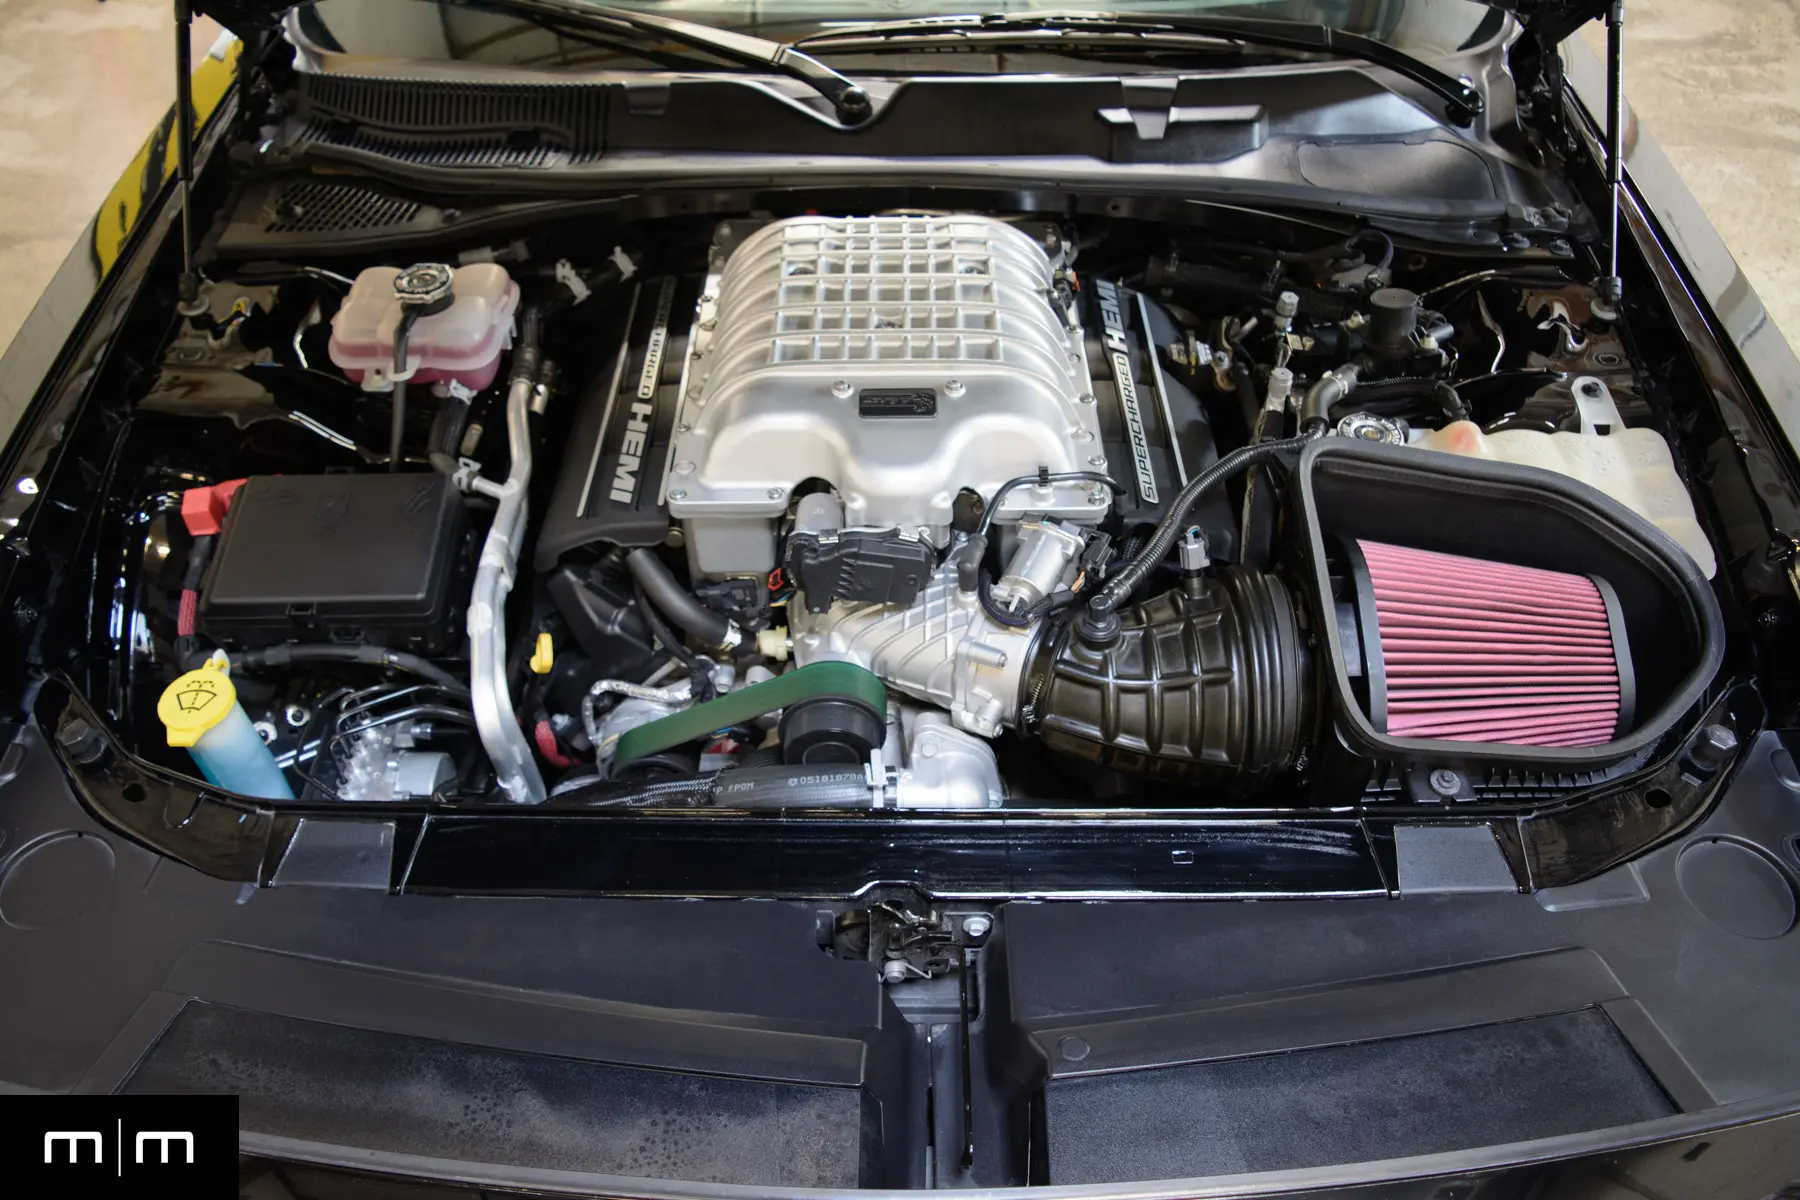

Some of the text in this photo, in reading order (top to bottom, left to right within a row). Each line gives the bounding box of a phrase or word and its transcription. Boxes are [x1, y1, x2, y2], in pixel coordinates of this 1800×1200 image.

[609, 279, 674, 503] CHARGED HEMI
[1096, 280, 1155, 500] SUPERCHARGED HEMI
